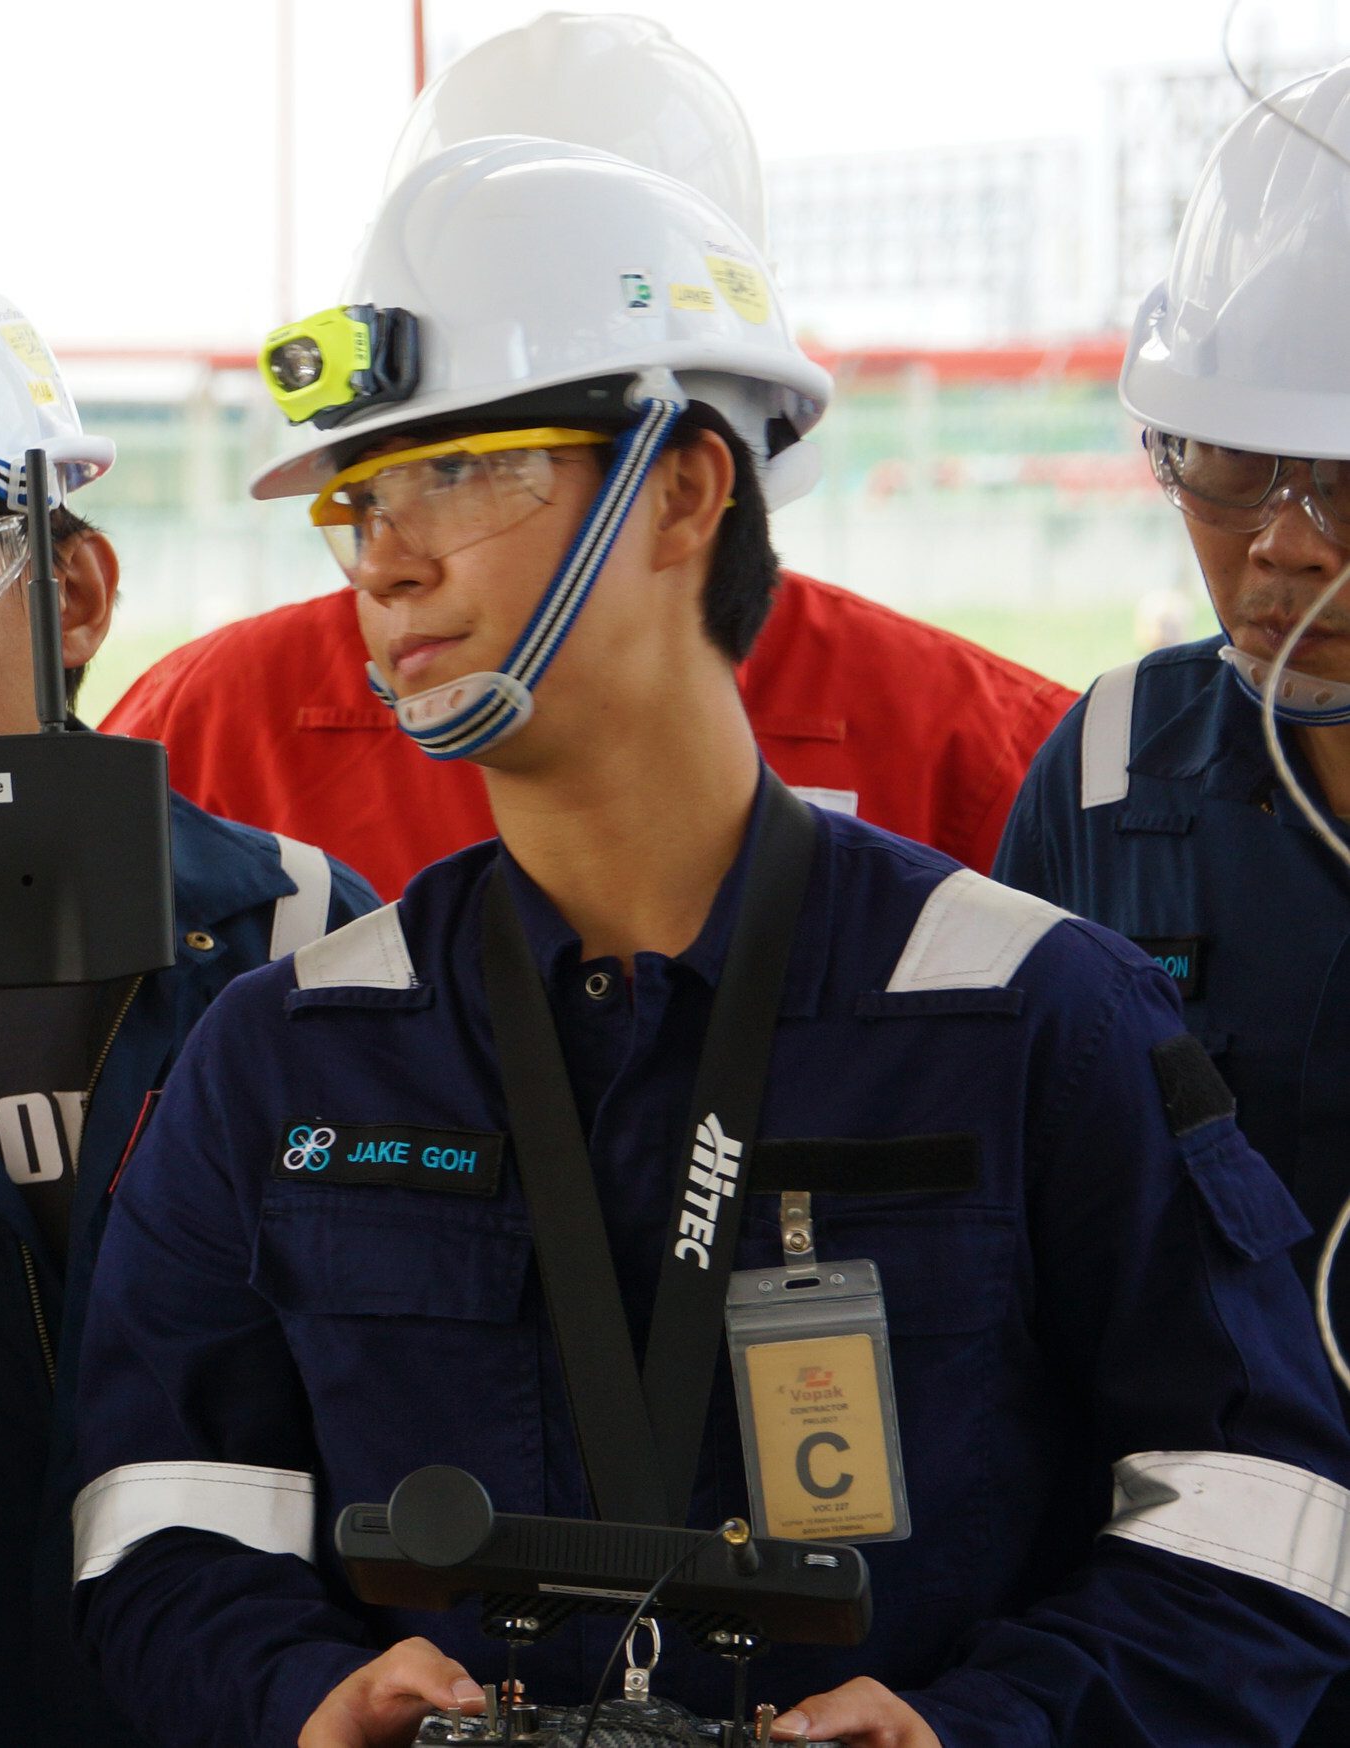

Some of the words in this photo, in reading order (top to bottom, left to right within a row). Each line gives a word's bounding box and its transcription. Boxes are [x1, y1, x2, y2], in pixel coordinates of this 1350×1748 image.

[347, 1141, 411, 1164] JAKE
[421, 1147, 477, 1173] GOH
[790, 1385, 844, 1402] Vopak
[790, 1403, 849, 1415] CONTRACTOR
[795, 1431, 853, 1499] C
